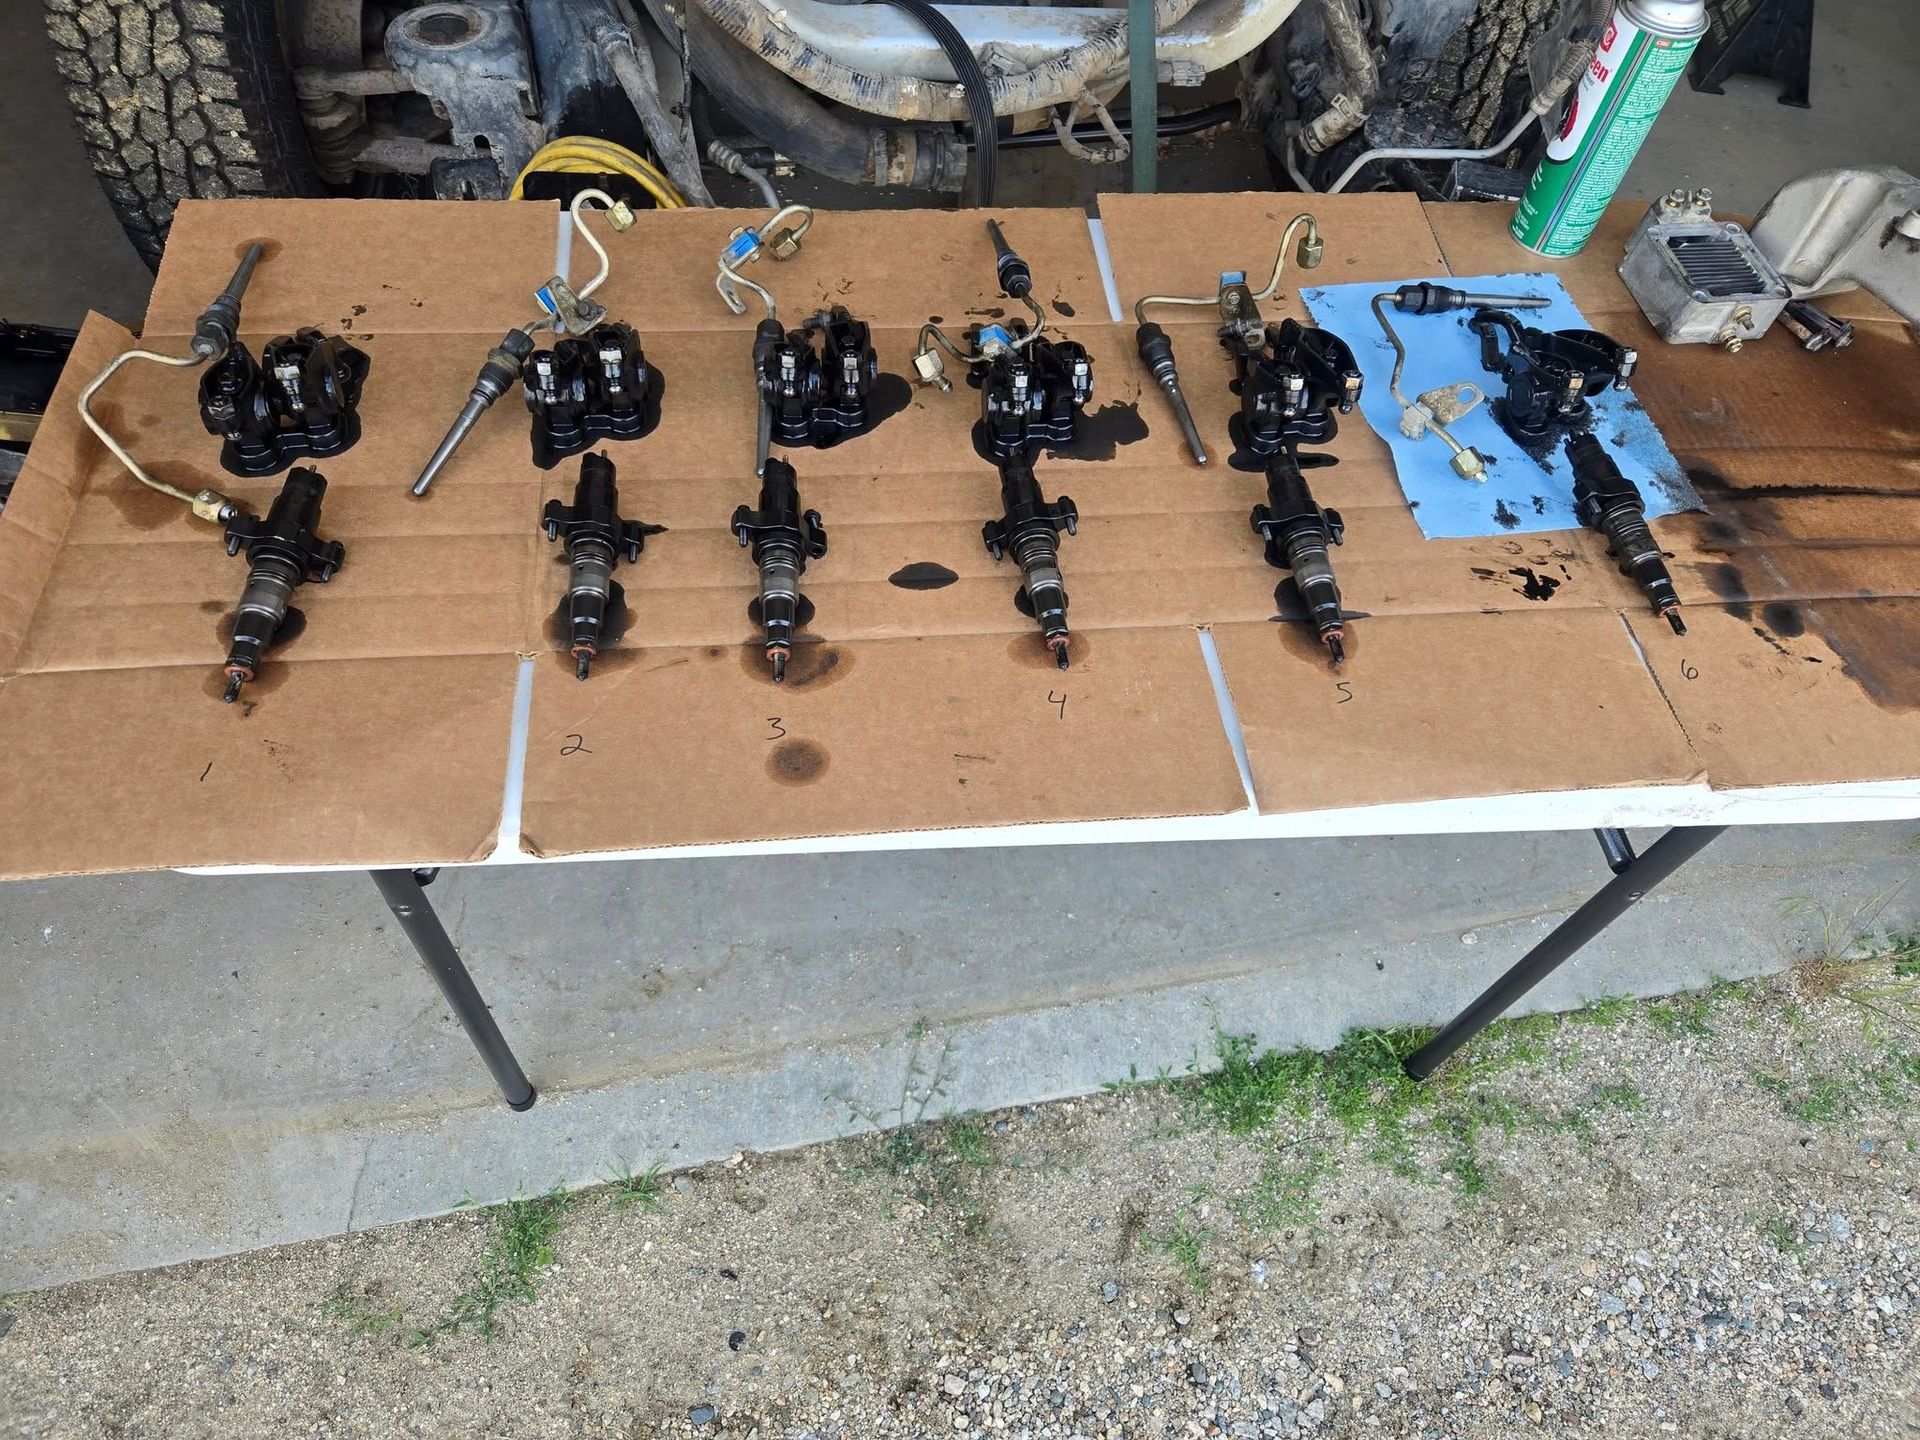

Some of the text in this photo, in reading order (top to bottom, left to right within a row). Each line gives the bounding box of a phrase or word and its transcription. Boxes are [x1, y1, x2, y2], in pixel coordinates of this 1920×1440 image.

[1681, 659, 1698, 681] 6
[1336, 682, 1352, 703] 5
[1048, 690, 1067, 719] 4
[766, 717, 786, 740] 3
[560, 734, 592, 756] 2
[200, 762, 213, 782] 1
